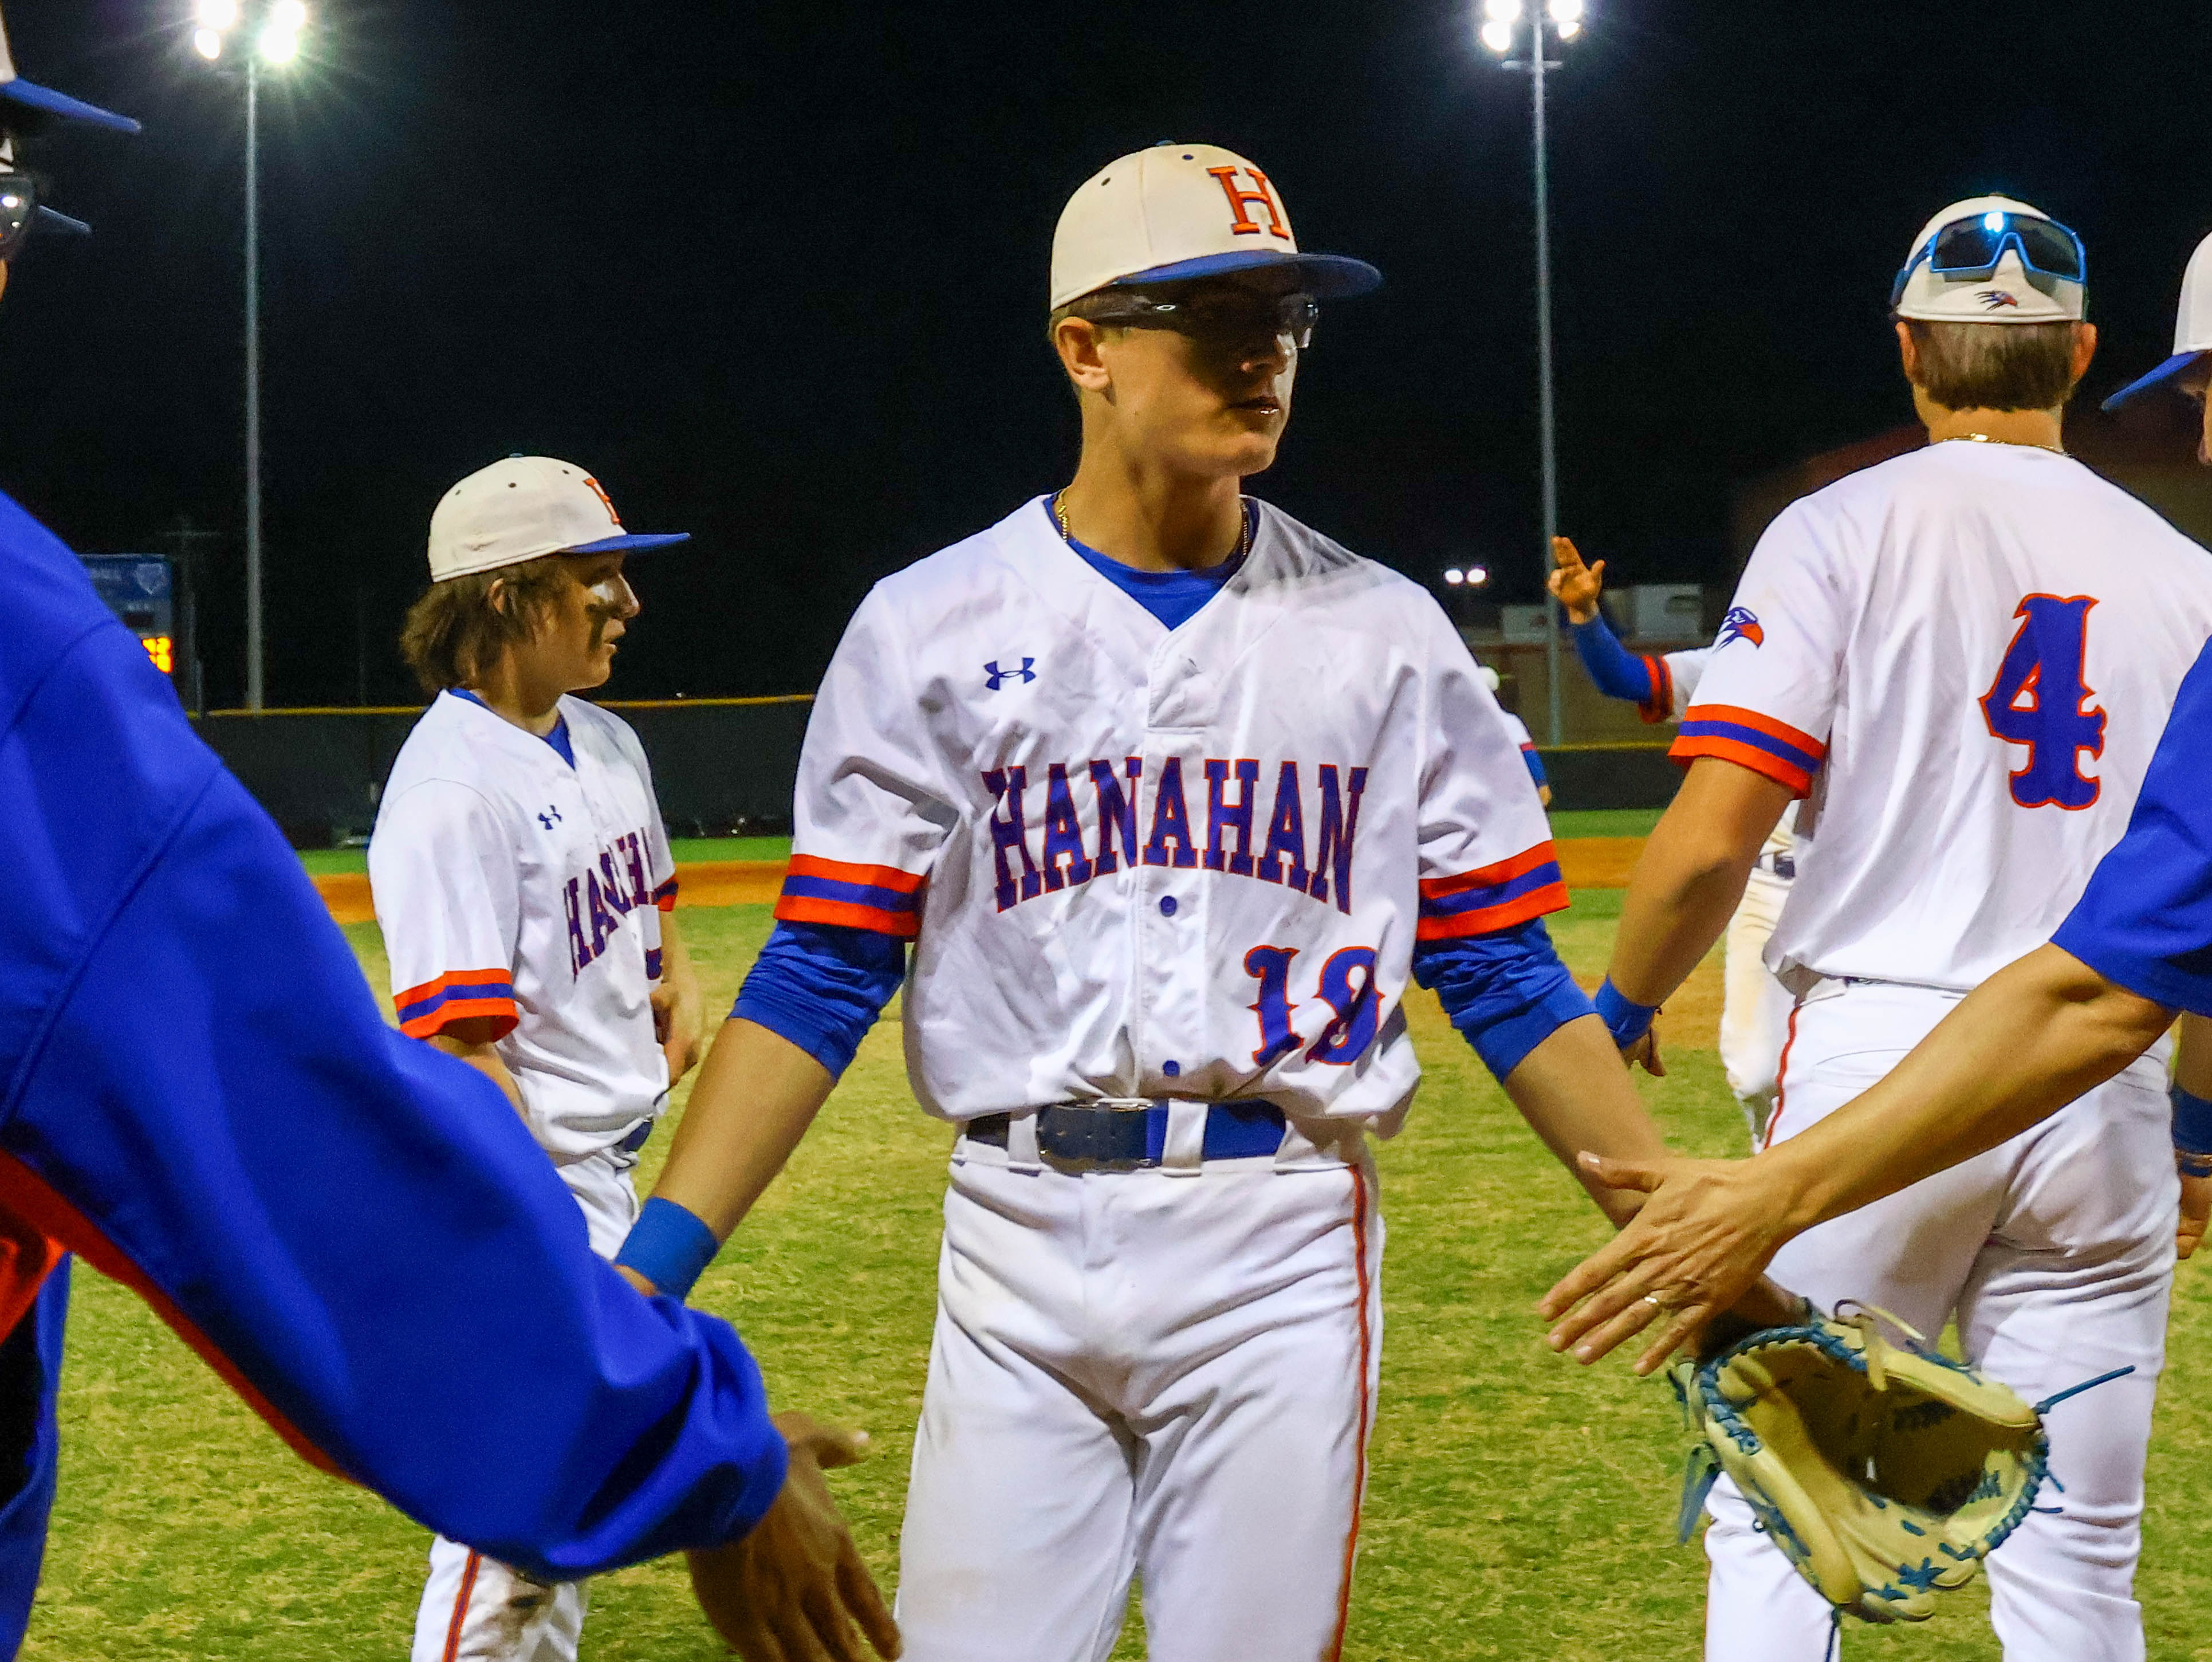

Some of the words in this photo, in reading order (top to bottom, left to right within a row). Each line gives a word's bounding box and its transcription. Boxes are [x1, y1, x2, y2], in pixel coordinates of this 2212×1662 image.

[1206, 166, 1289, 240] H
[1978, 592, 2107, 811] 4
[981, 756, 1369, 916] HANAHAN
